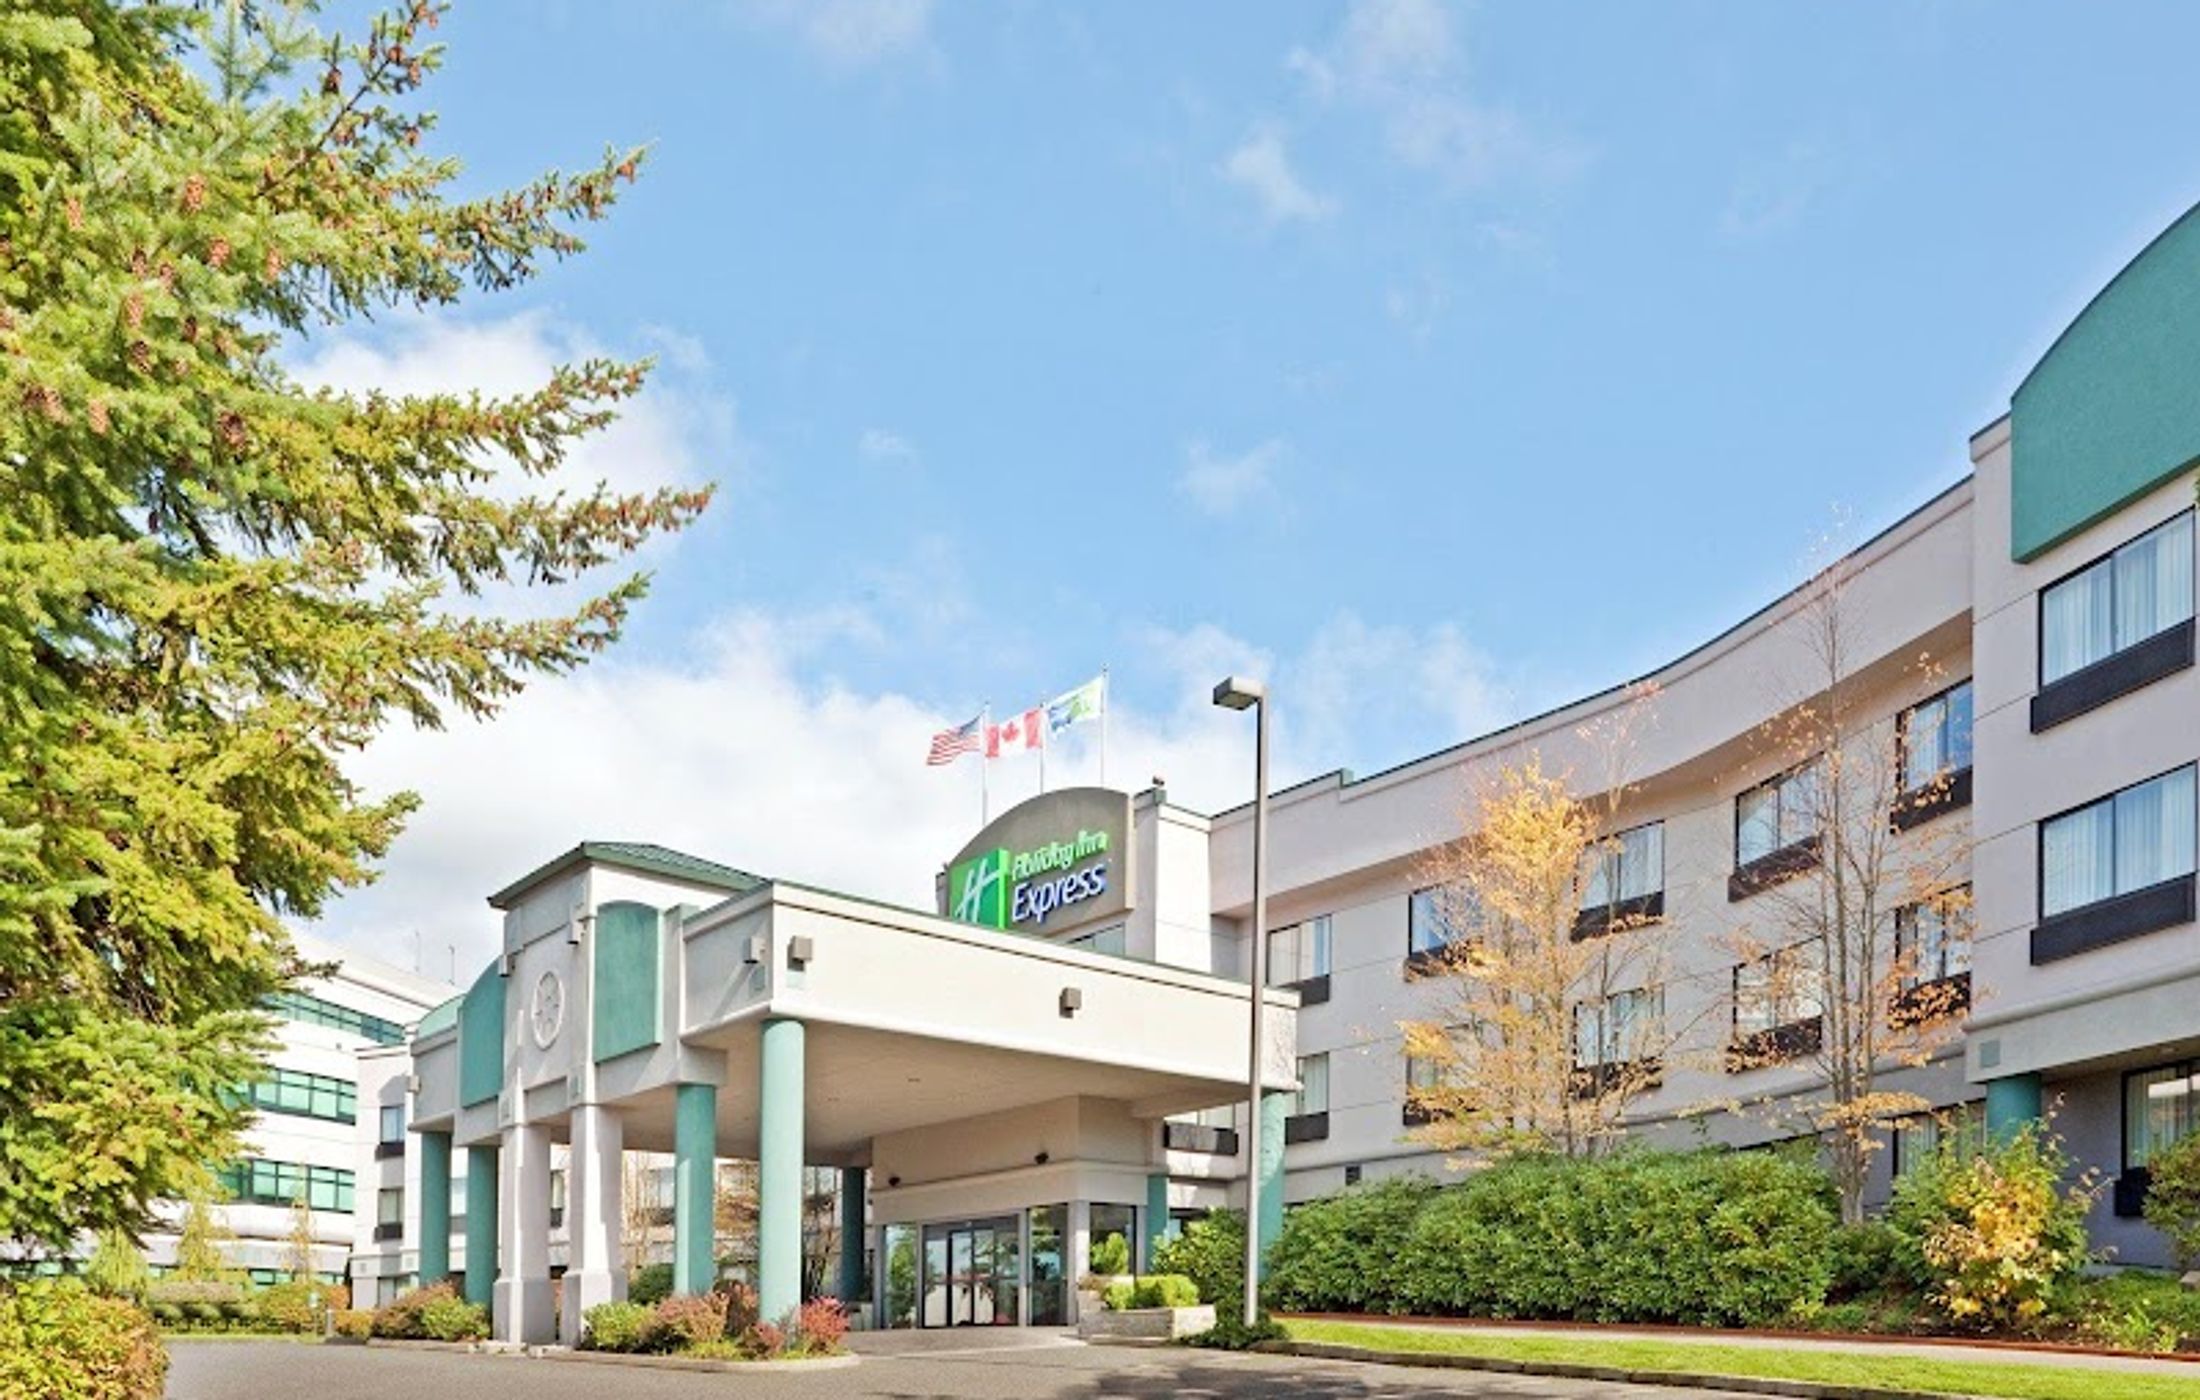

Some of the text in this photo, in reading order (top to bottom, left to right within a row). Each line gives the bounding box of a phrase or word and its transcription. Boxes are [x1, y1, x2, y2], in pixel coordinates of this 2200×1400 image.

[1012, 830, 1109, 881] Holiday Inn
[1012, 863, 1106, 923] Express
